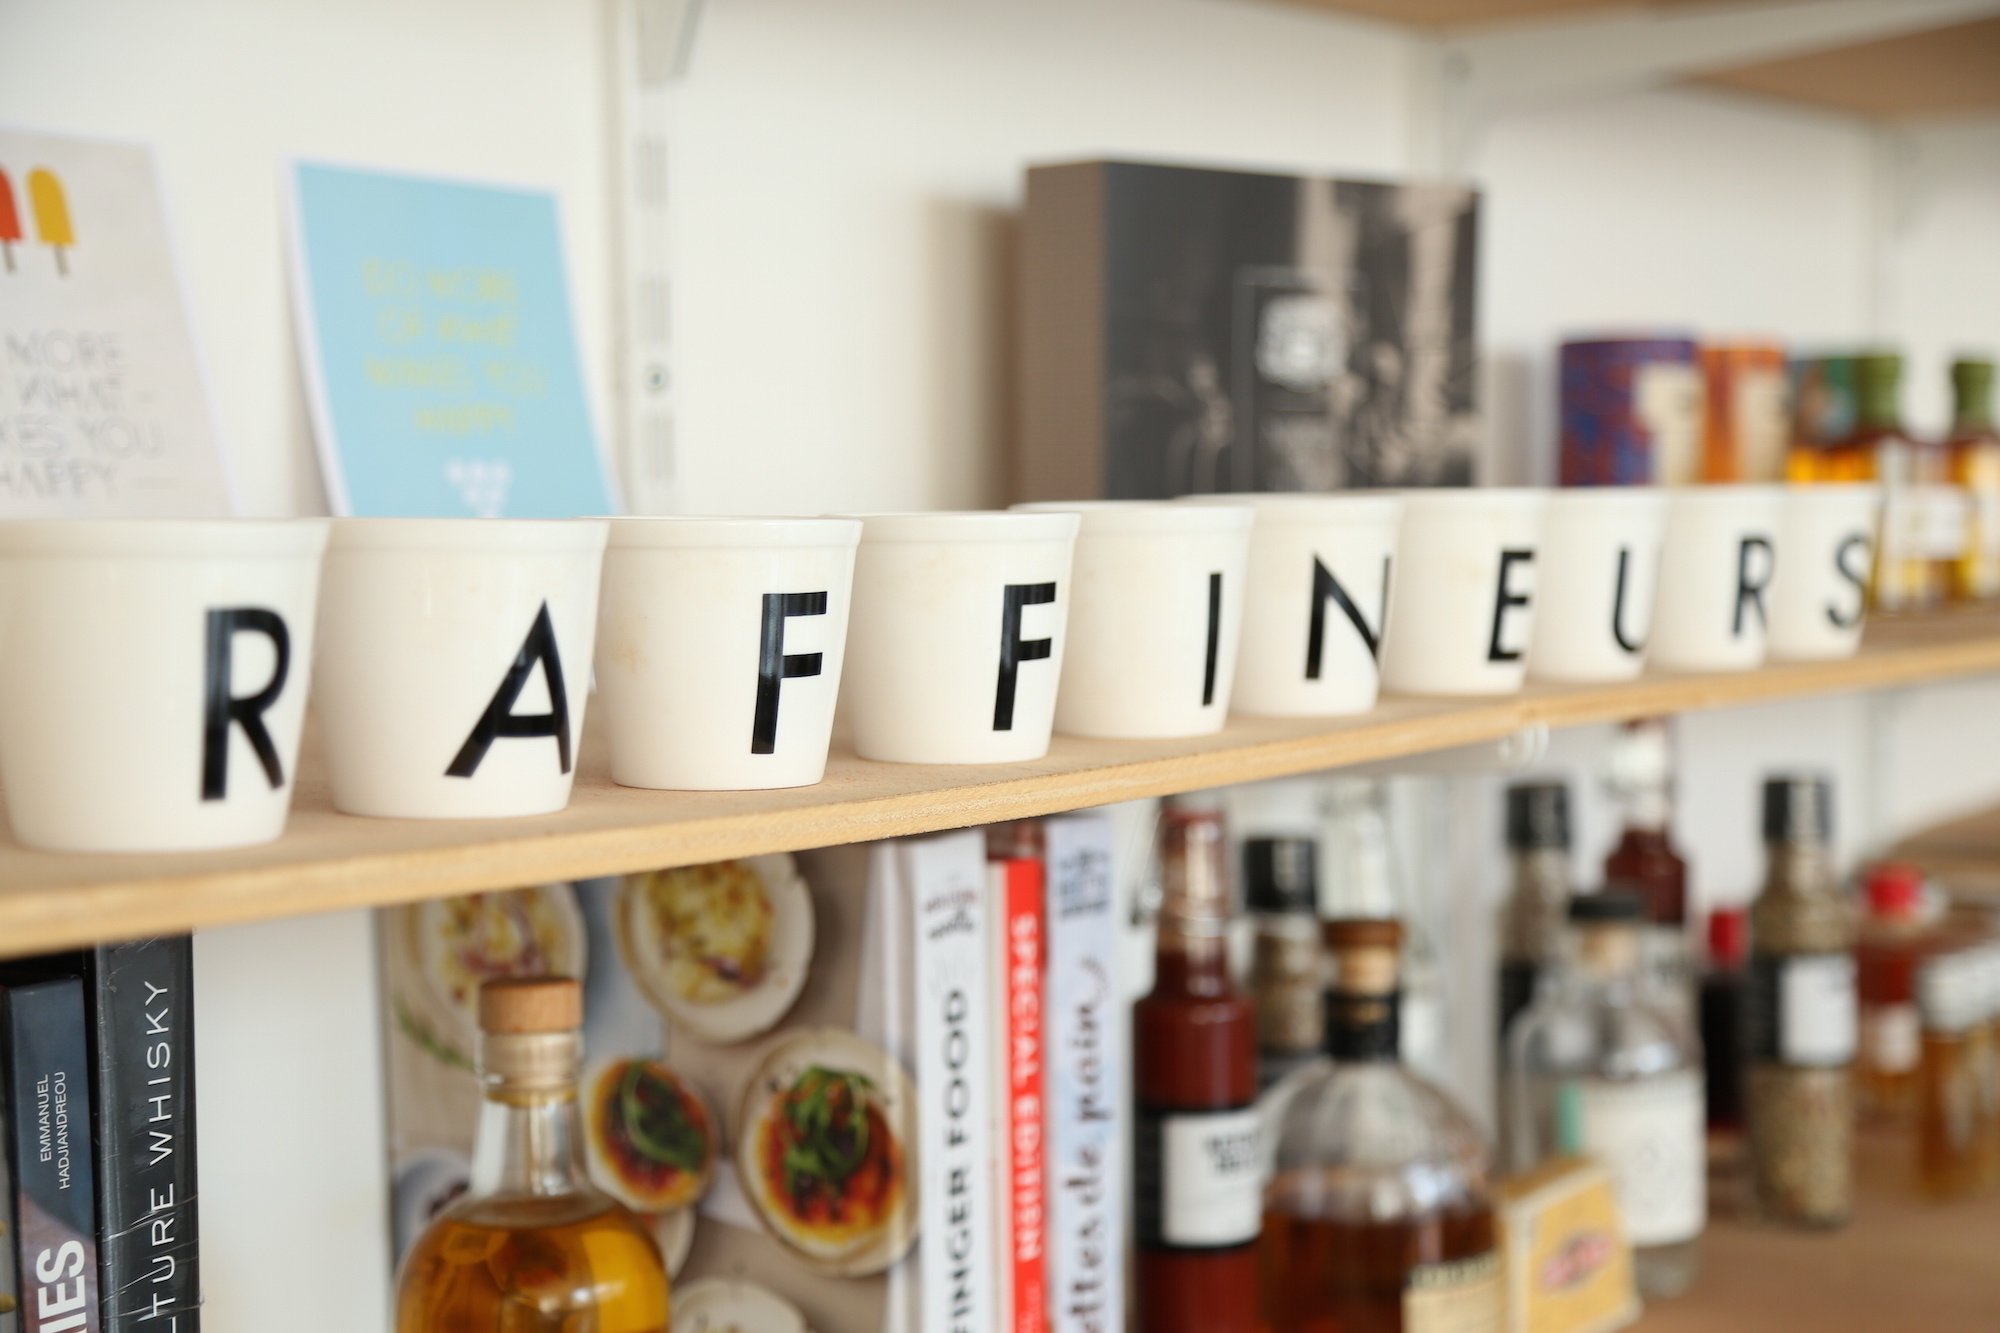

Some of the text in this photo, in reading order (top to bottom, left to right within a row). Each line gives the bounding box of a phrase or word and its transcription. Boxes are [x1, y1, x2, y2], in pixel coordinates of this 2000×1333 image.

[76, 416, 166, 461] YOU
[200, 605, 293, 802] R
[442, 599, 572, 778] A
[749, 590, 829, 755] F
[991, 581, 1057, 732] F
[1202, 571, 1223, 707] I
[1305, 551, 1392, 681] N
[1487, 547, 1536, 662] E
[1731, 535, 1776, 638] R
[1827, 532, 1873, 630] S
[942, 989, 970, 1149] FOOD
[1010, 914, 1041, 1089] SPECIAL
[37, 1074, 53, 1163] EMMANUEL
[54, 1071, 71, 1190] HADJIANDREOU
[144, 980, 174, 1167] WHISKY
[36, 1240, 87, 1333] IES
